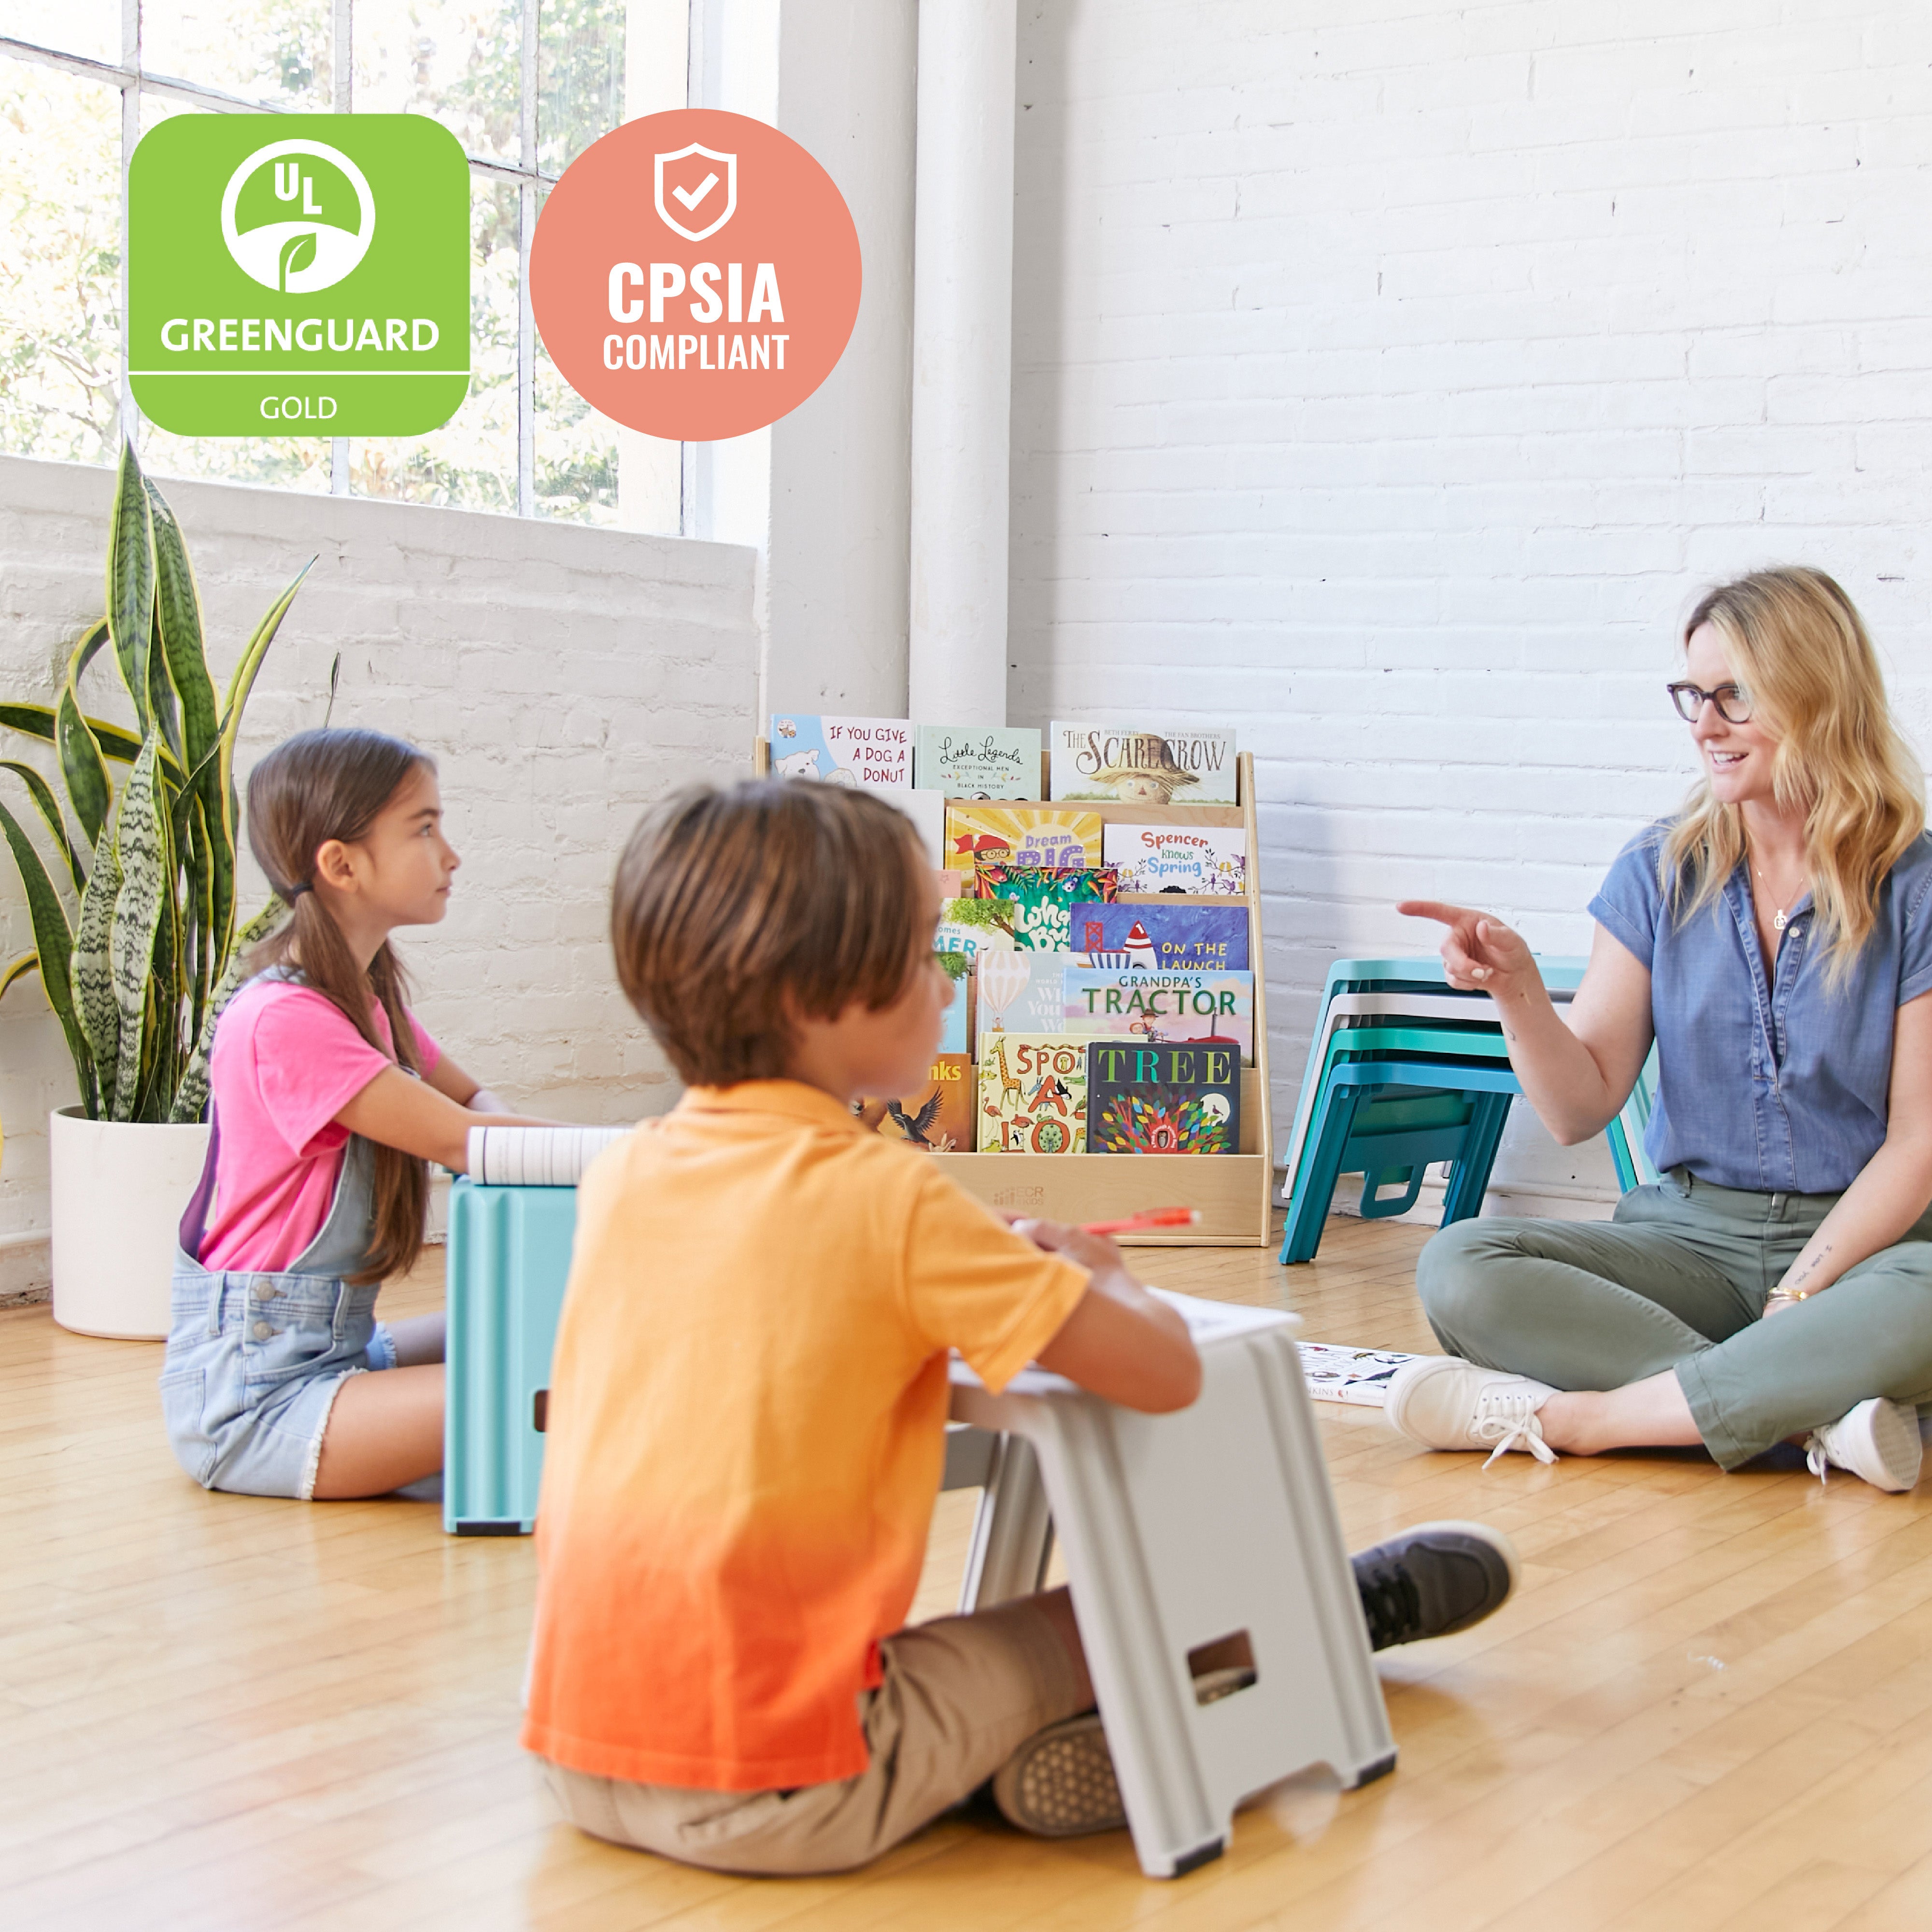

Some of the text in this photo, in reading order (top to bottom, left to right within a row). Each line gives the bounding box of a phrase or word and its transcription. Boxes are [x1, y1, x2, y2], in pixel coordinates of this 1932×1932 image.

[829, 726, 907, 744] IF YOU GIVE
[852, 747, 905, 763] A DOG A
[938, 735, 1023, 765] Little Legends
[1076, 730, 1227, 775] SCARECROW
[864, 767, 905, 782] DONUT
[1026, 835, 1072, 849] Dream
[1141, 832, 1208, 849] Spencer
[1148, 857, 1202, 878] Spring
[1162, 942, 1227, 956] ON THE
[1162, 960, 1225, 970] LAUNCH
[1119, 976, 1202, 988] GRANDPA'S
[1082, 988, 1236, 1015] TRACTOR
[928, 1061, 962, 1081] nks
[1098, 1050, 1231, 1084] TREE
